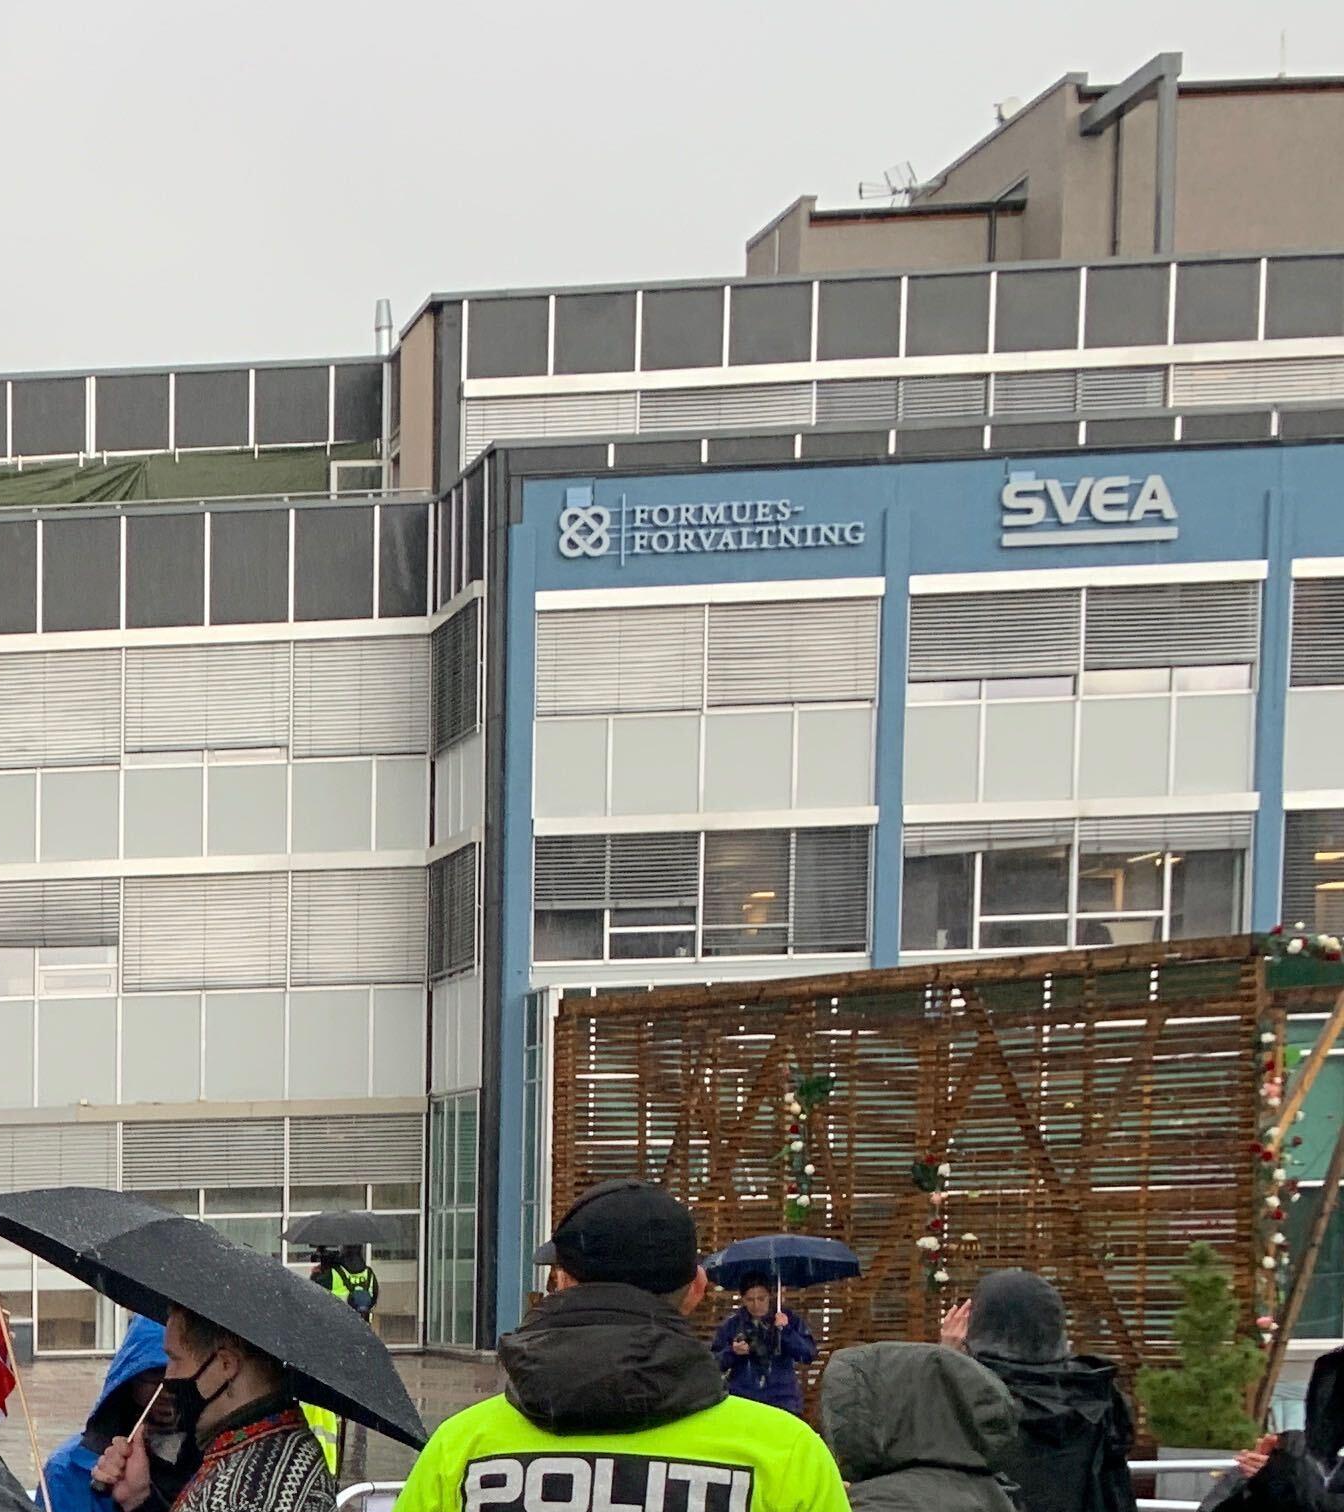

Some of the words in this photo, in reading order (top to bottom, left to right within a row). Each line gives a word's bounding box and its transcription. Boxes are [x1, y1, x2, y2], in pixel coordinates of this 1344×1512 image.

[633, 499, 805, 527] FORMUES-
[1002, 474, 1178, 527] SVEA
[633, 522, 867, 553] FORVALTNING
